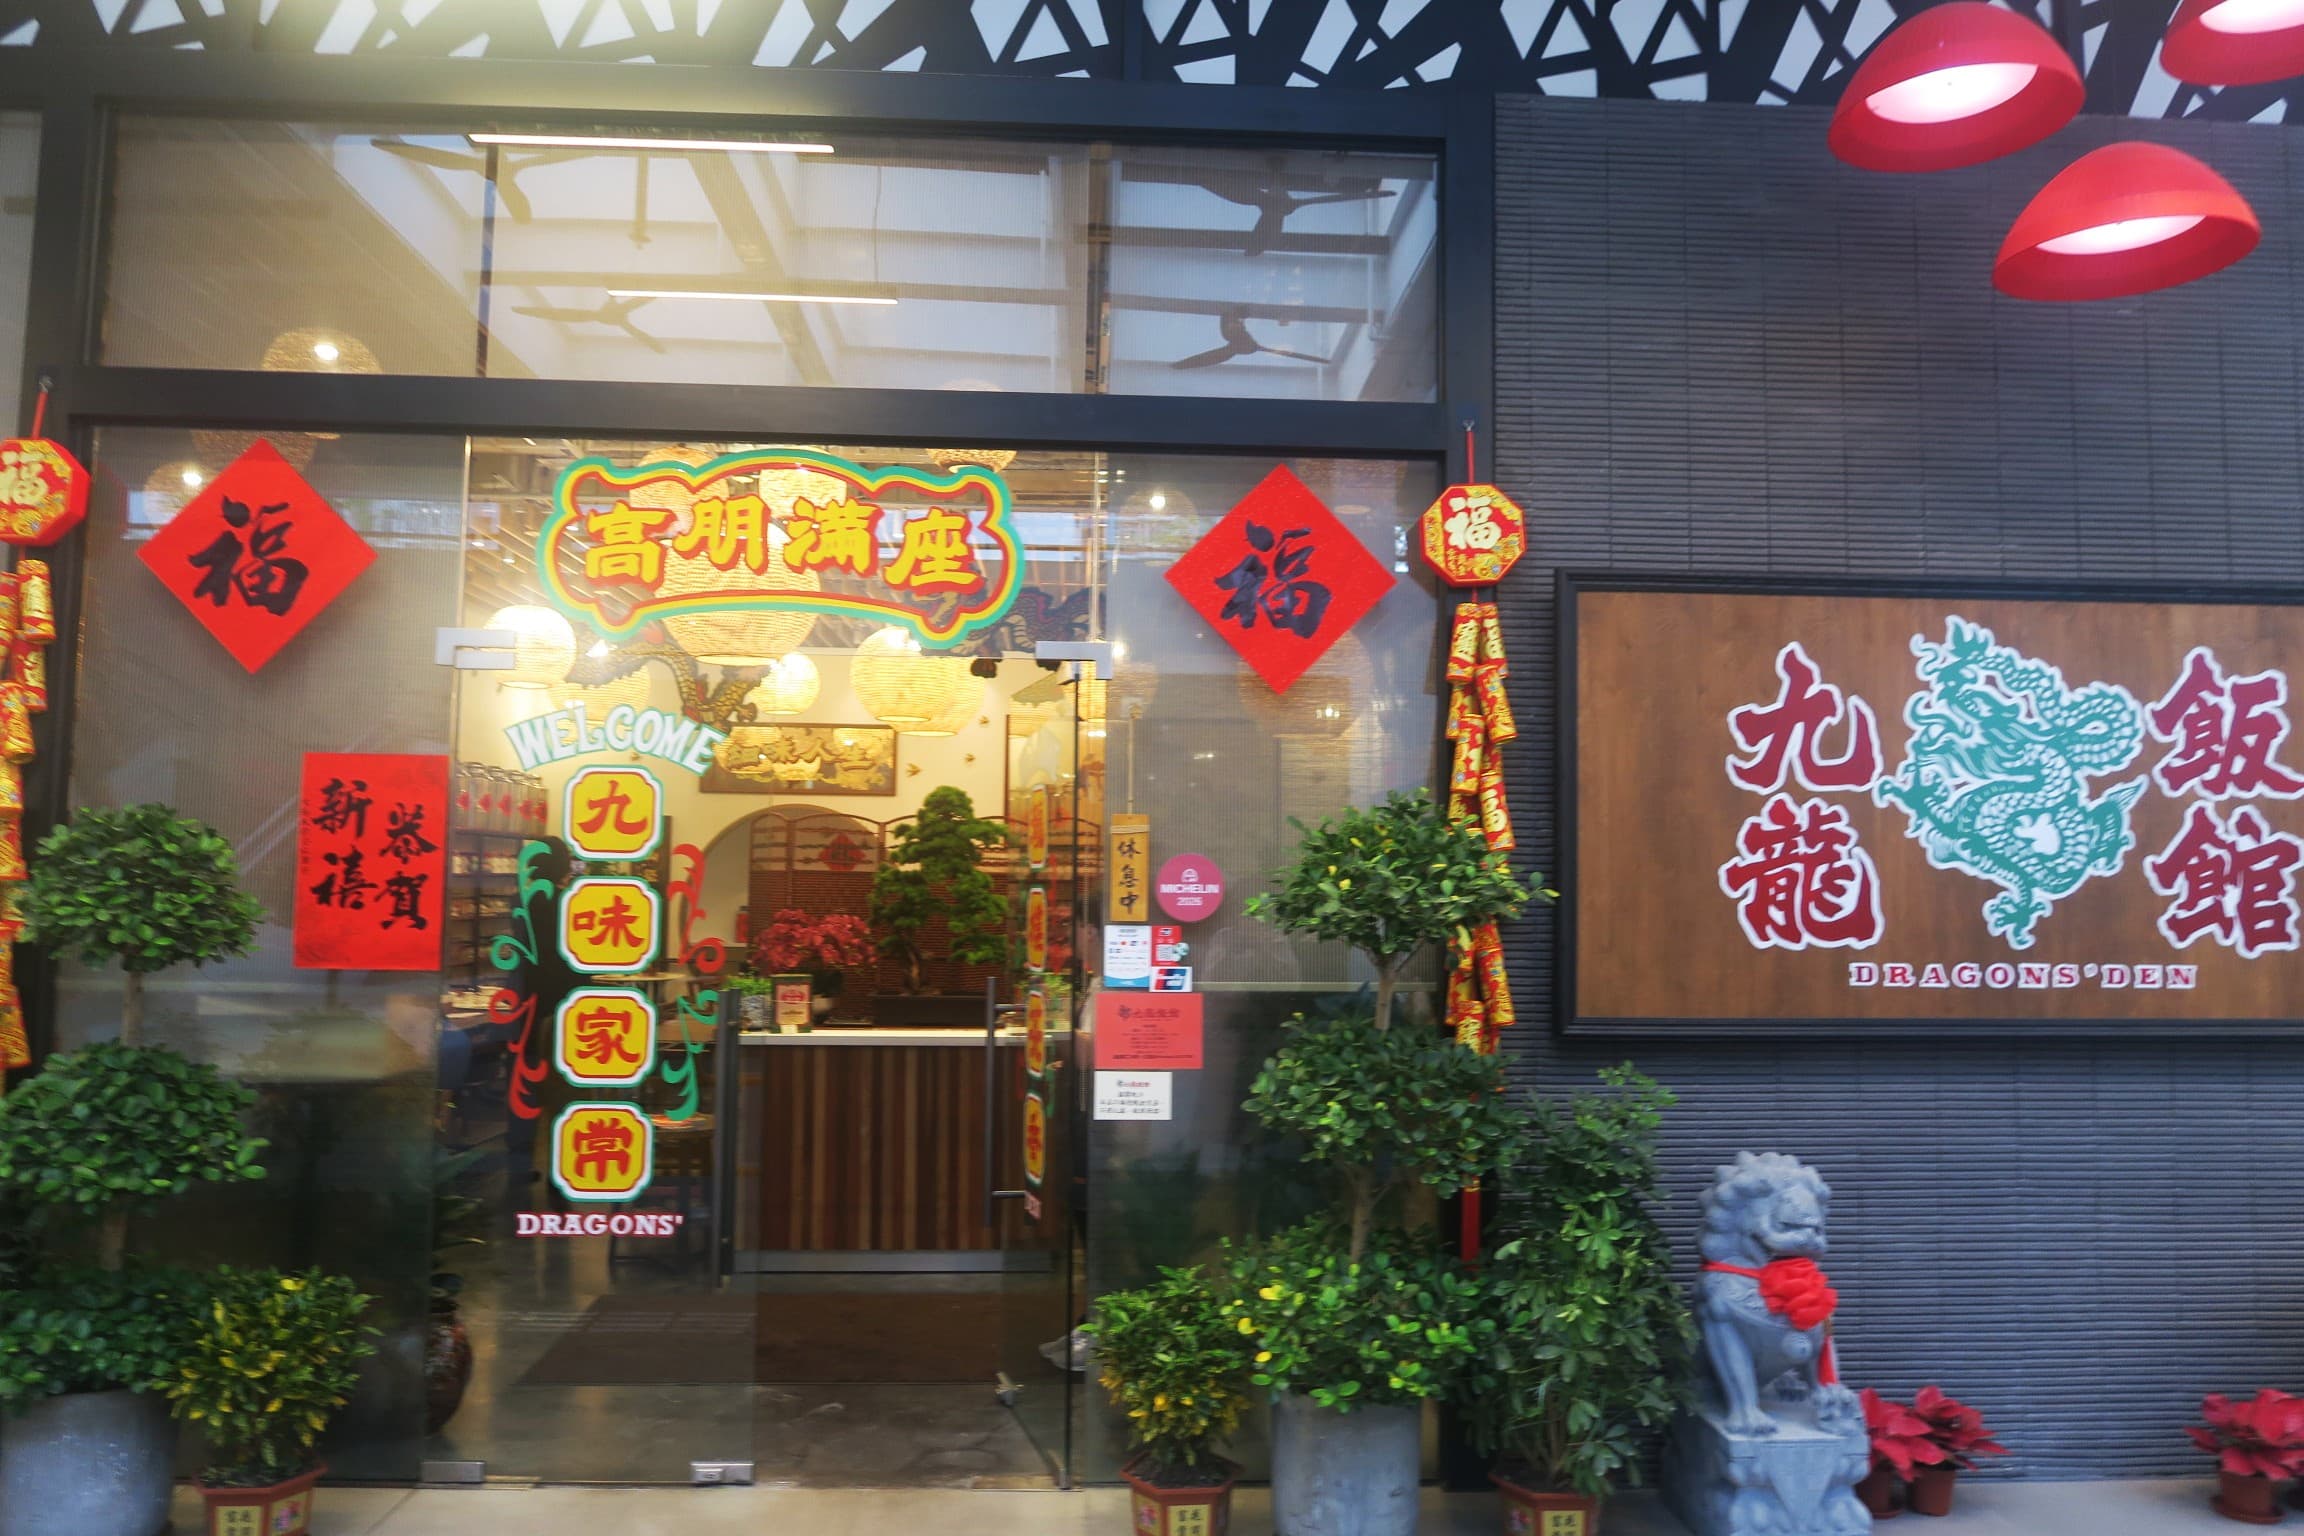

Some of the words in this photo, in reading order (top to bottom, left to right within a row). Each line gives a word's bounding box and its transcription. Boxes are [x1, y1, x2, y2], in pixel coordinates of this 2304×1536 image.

[188, 495, 309, 618] 福
[1444, 496, 1501, 549] 福
[1214, 519, 1333, 640] 福
[503, 700, 732, 777] WELCOME
[1118, 838, 1142, 915] 休息中
[1160, 883, 1220, 894] MICHELIN
[571, 779, 649, 1184] 九味家常
[516, 1211, 685, 1238] DRAGONS'
